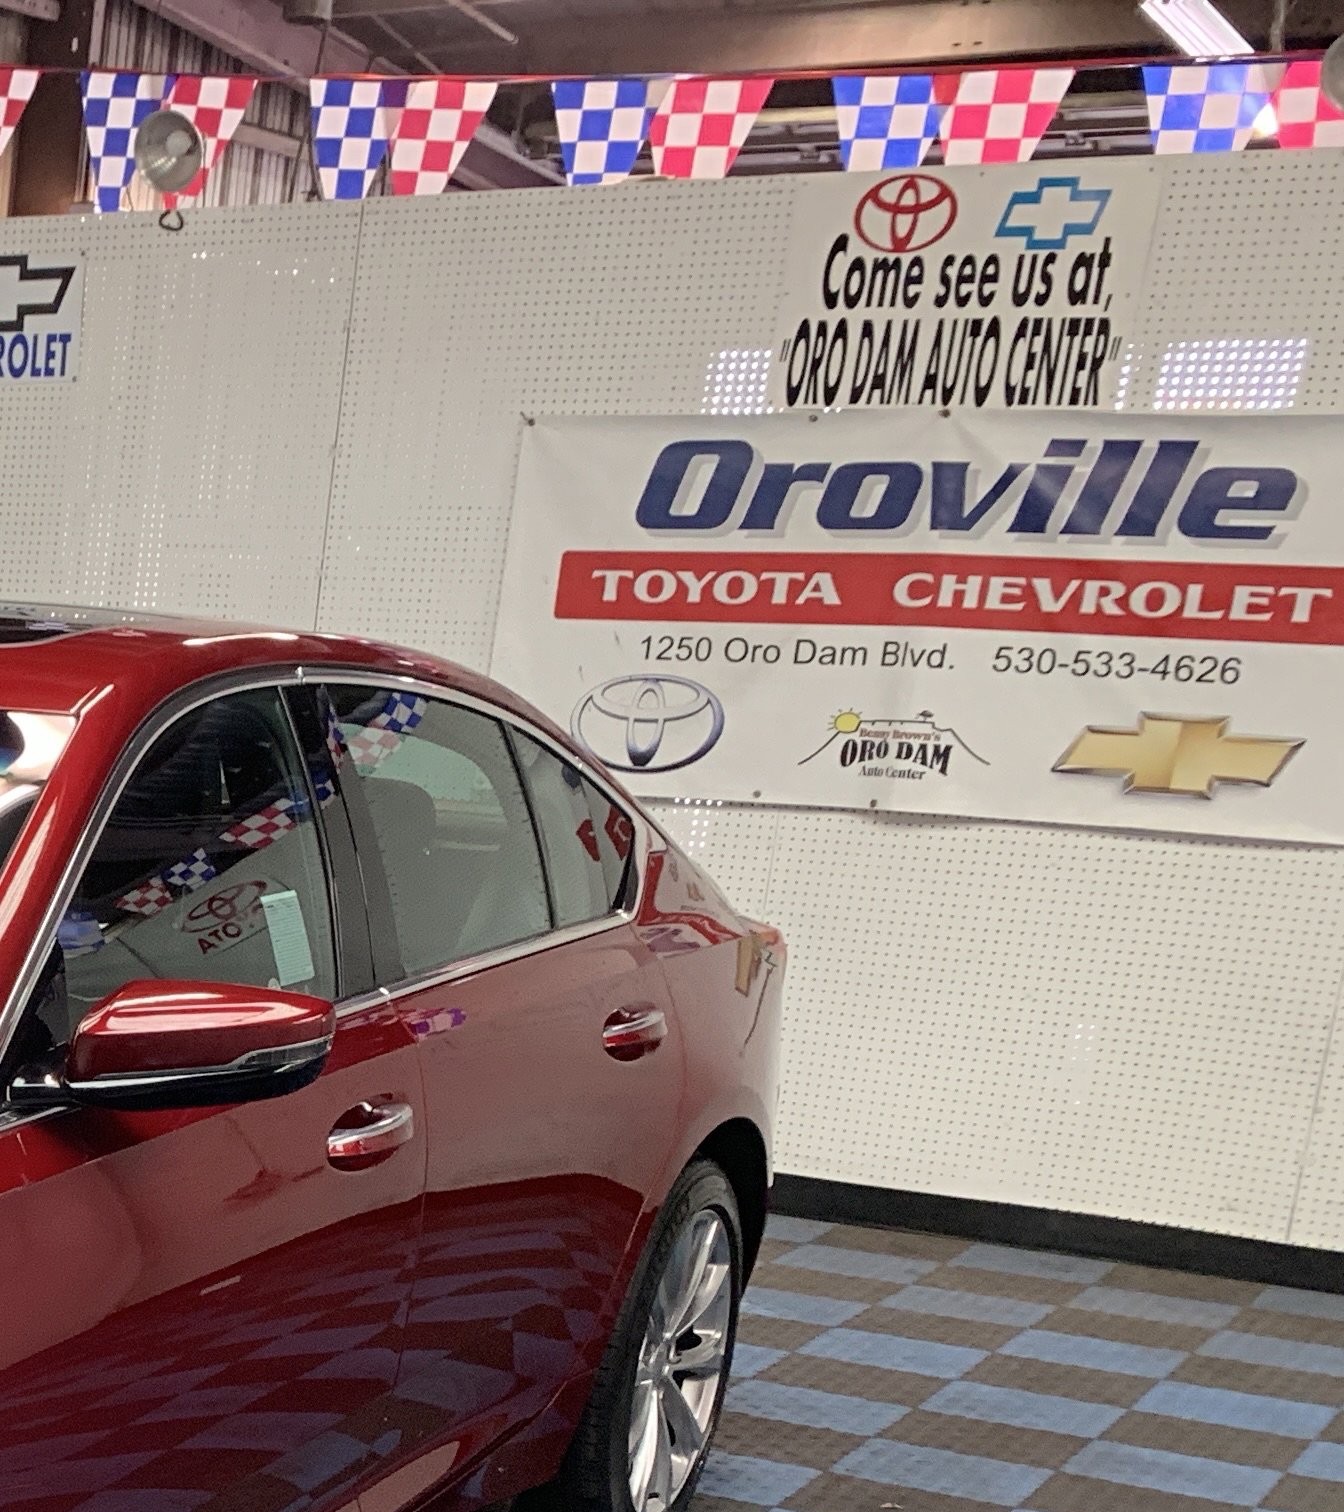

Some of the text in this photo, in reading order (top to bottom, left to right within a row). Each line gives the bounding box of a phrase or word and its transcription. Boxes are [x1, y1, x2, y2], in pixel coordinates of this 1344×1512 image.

[822, 232, 1113, 312] Come see us at,
[779, 315, 1123, 408] "ORO DAM AUTO CENTER"
[635, 438, 1300, 542] Oroville
[591, 567, 1334, 624] TOYOTA CHEVROLET
[639, 634, 1244, 686] 1250 Oro Dam Blvd. 530-533-4626
[840, 738, 954, 776] ORO DAM
[859, 728, 942, 742] Benny Brown's
[858, 765, 927, 780] Auto Center
